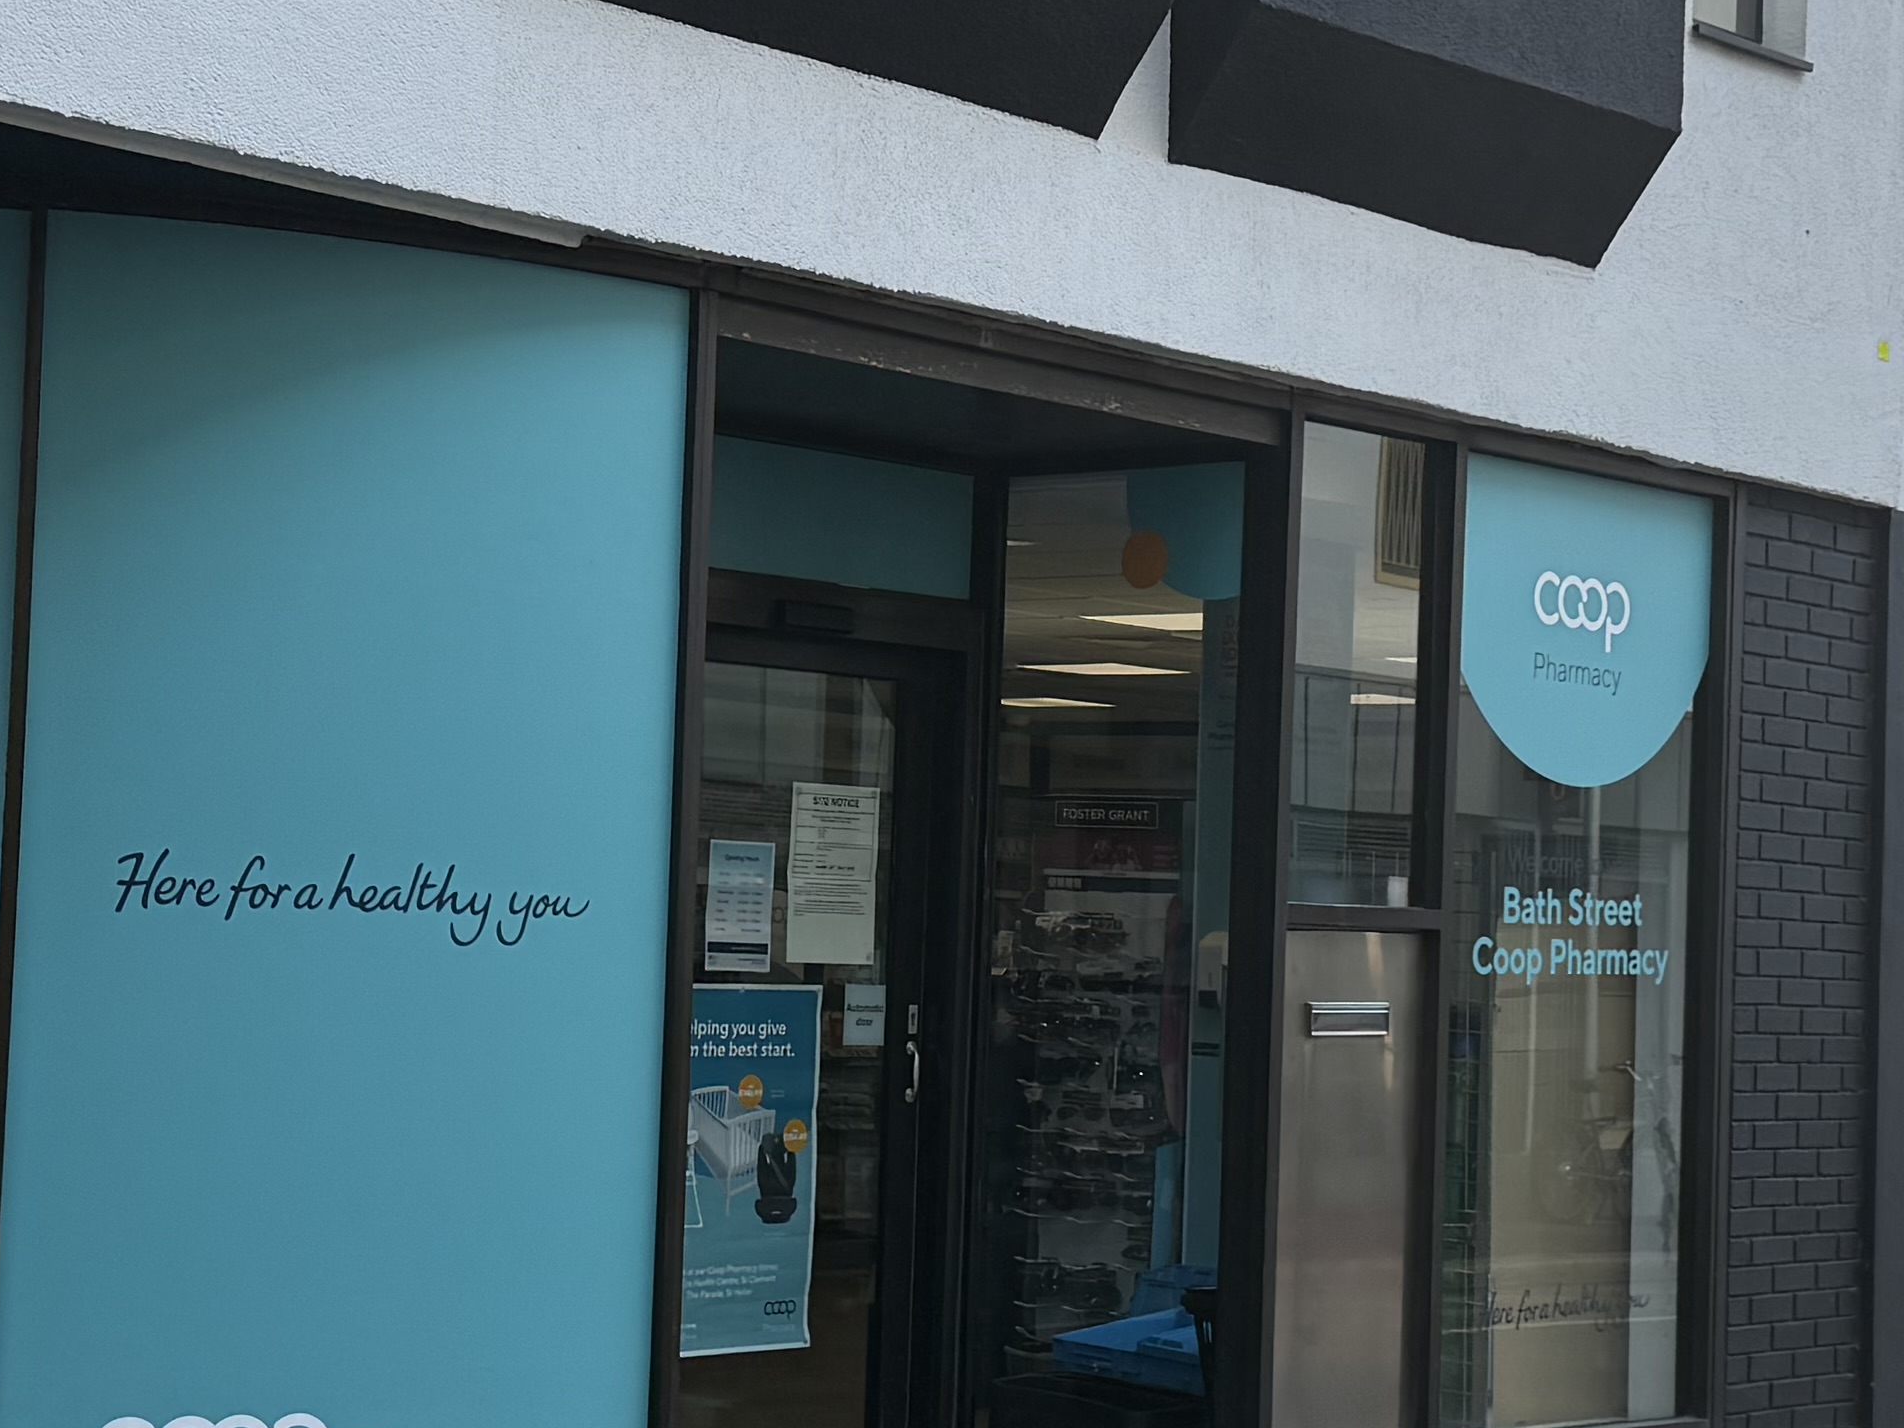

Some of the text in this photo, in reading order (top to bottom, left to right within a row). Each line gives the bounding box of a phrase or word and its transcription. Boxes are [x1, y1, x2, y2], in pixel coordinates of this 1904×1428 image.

[1534, 571, 1630, 653] coop
[1533, 652, 1622, 696] Pharmacy
[1063, 808, 1150, 821] FOSTER GRANT
[115, 848, 590, 947] Here for a healthy you
[1503, 886, 1643, 927] Bath Street
[1472, 936, 1669, 986] Coop Pharmacy
[703, 1041, 725, 1057] the
[728, 1042, 757, 1057] best
[761, 1043, 795, 1057] start.
[731, 1023, 755, 1039] you
[758, 1019, 786, 1040] give
[764, 1299, 796, 1319] coop
